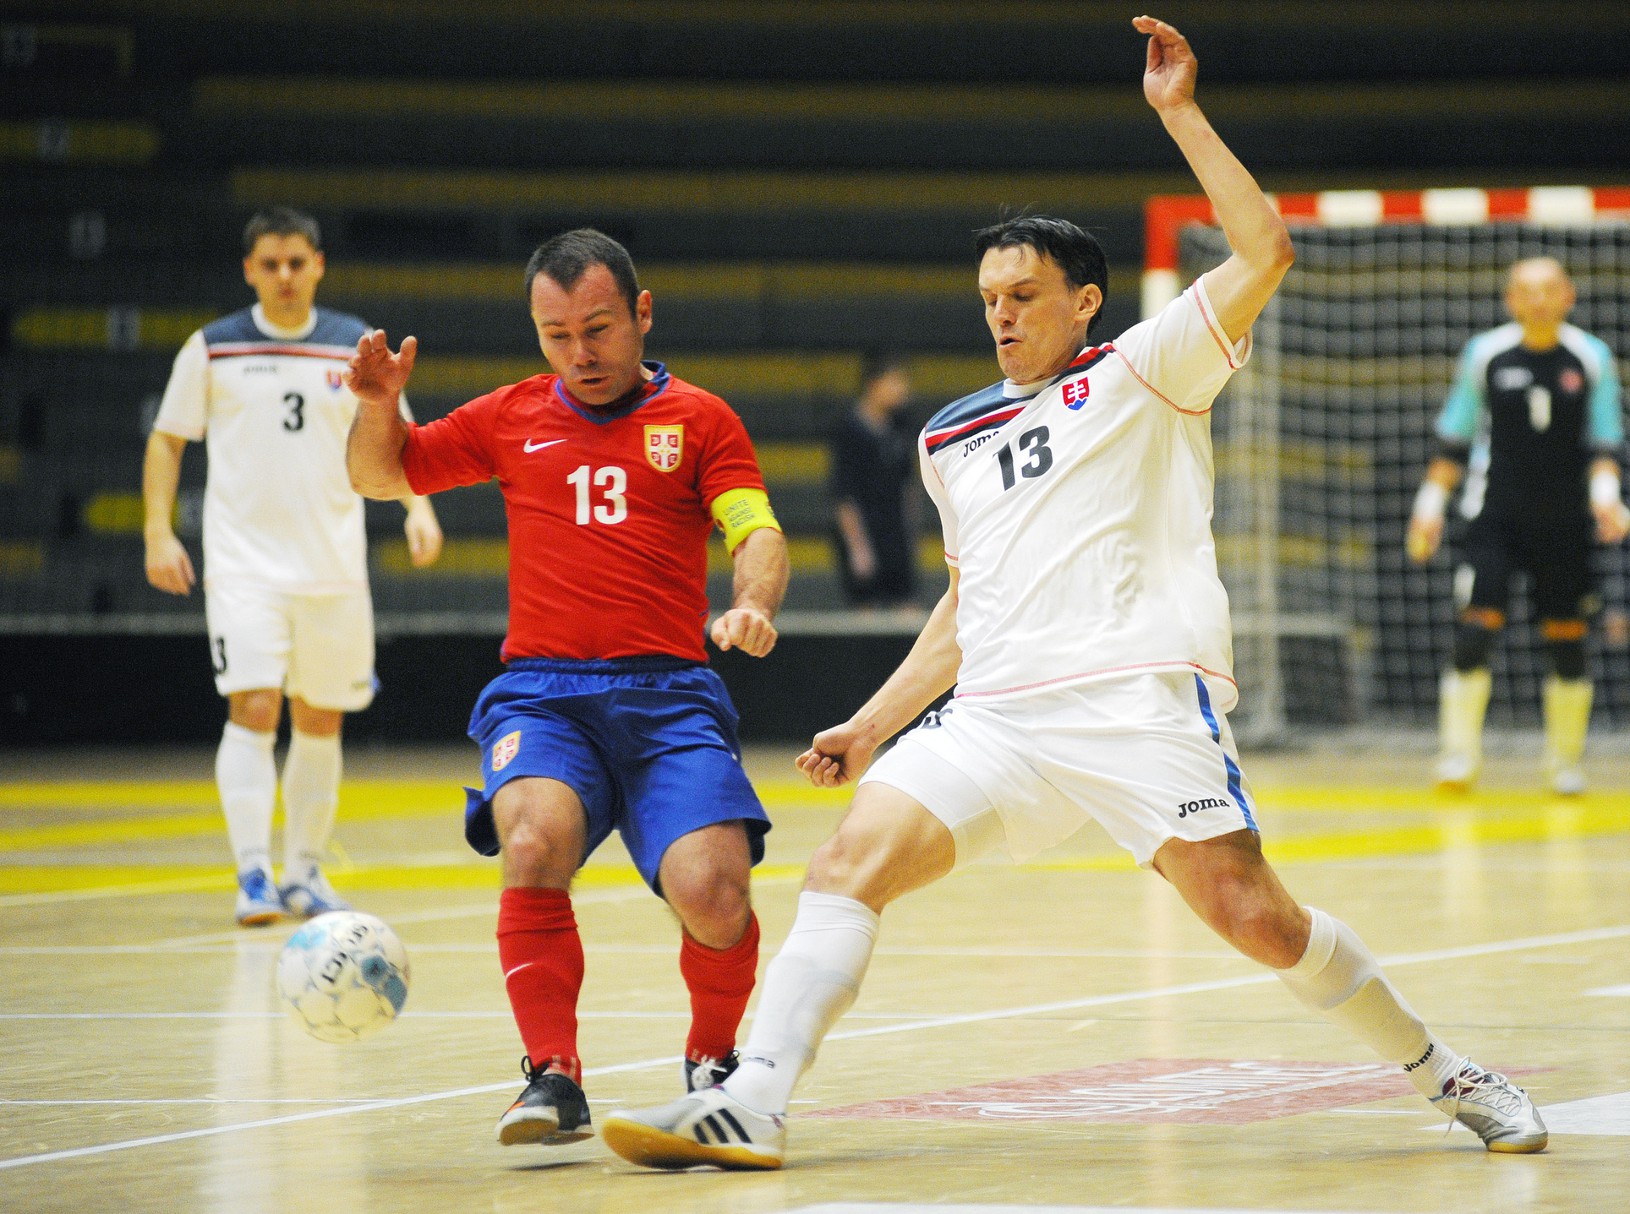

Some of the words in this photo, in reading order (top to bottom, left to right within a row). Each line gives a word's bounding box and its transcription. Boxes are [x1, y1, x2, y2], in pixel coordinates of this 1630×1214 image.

[283, 391, 304, 432] 3
[992, 425, 1054, 491] 13
[566, 465, 628, 525] 13
[213, 637, 228, 674] 3
